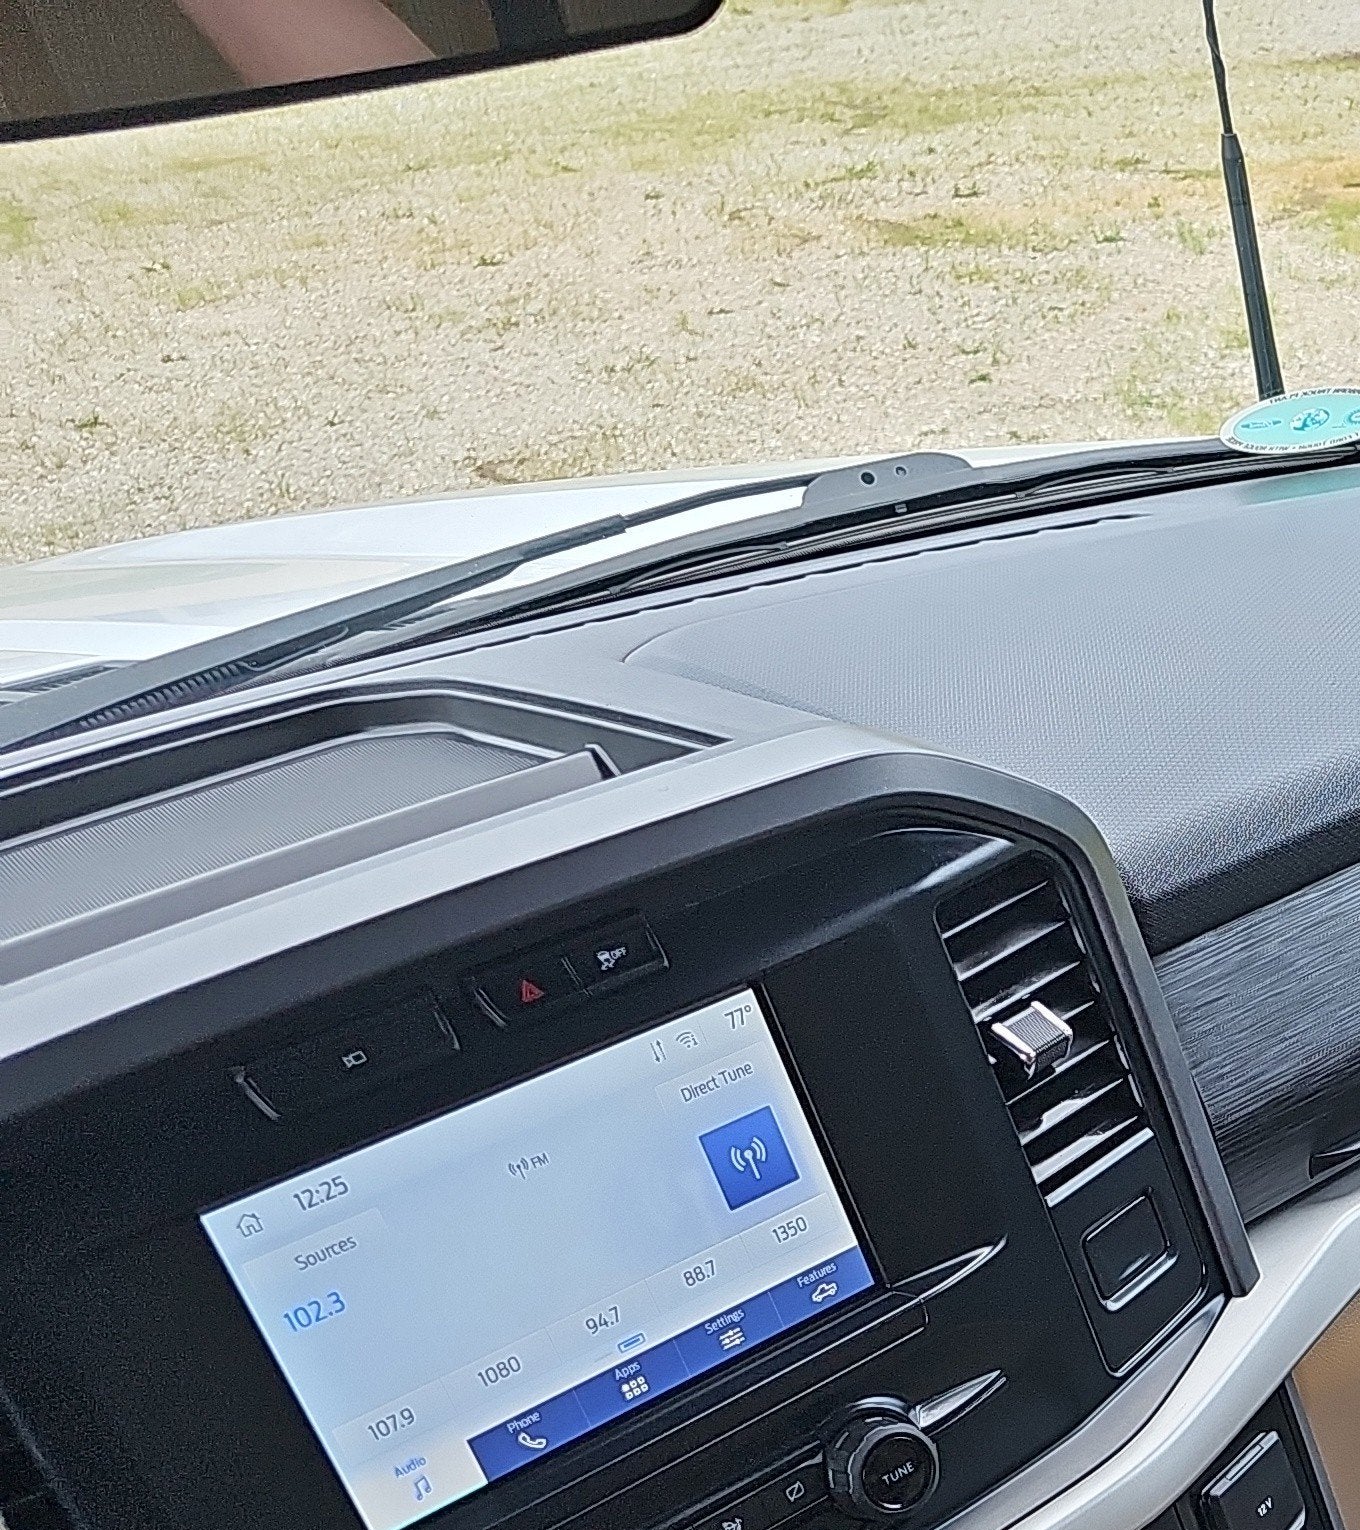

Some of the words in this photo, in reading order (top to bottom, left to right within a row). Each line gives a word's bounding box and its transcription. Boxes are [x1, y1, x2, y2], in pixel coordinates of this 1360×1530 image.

[724, 1004, 752, 1030] 77°
[680, 1075, 720, 1102] Direct
[718, 1063, 754, 1085] Tune
[530, 1153, 550, 1169] FM
[293, 1175, 349, 1211] 12:25
[772, 1216, 808, 1245] 1350
[294, 1236, 357, 1271] Sources
[683, 1260, 717, 1288] 88.7
[796, 1262, 837, 1288] Features
[283, 1291, 346, 1332] 102.3
[585, 1306, 621, 1335] 94.7
[704, 1306, 745, 1337] Settings
[477, 1356, 522, 1387] 1080
[614, 1361, 641, 1381] Apps
[368, 1407, 415, 1441] 107.9
[507, 1411, 541, 1434] Phone
[394, 1456, 427, 1479] Audio
[881, 1461, 915, 1487] TUNE
